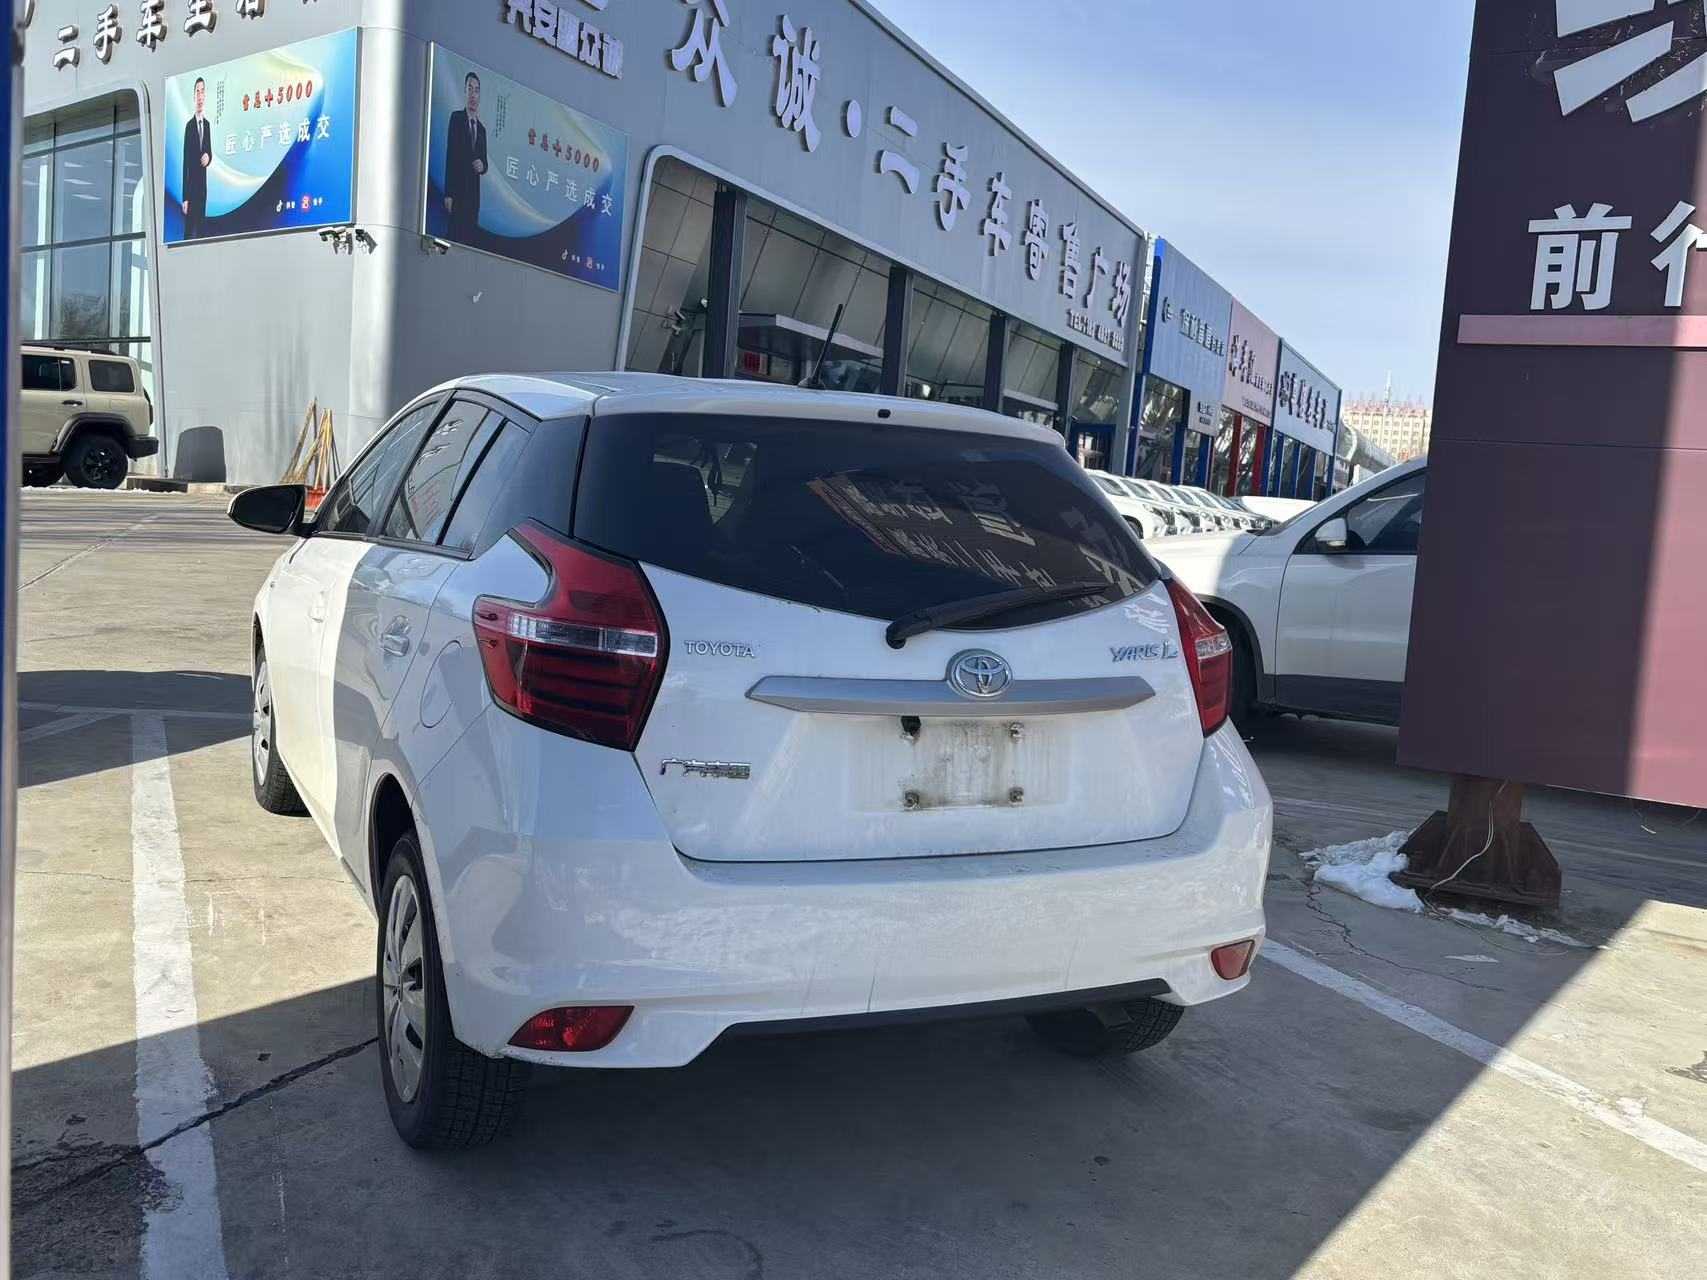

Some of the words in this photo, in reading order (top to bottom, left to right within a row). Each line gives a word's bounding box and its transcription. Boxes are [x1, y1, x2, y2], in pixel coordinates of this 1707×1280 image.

[225, 114, 331, 156] 匠心严选成交
[506, 155, 614, 217] 匠心严选成交
[685, 640, 755, 658] TOYOTA
